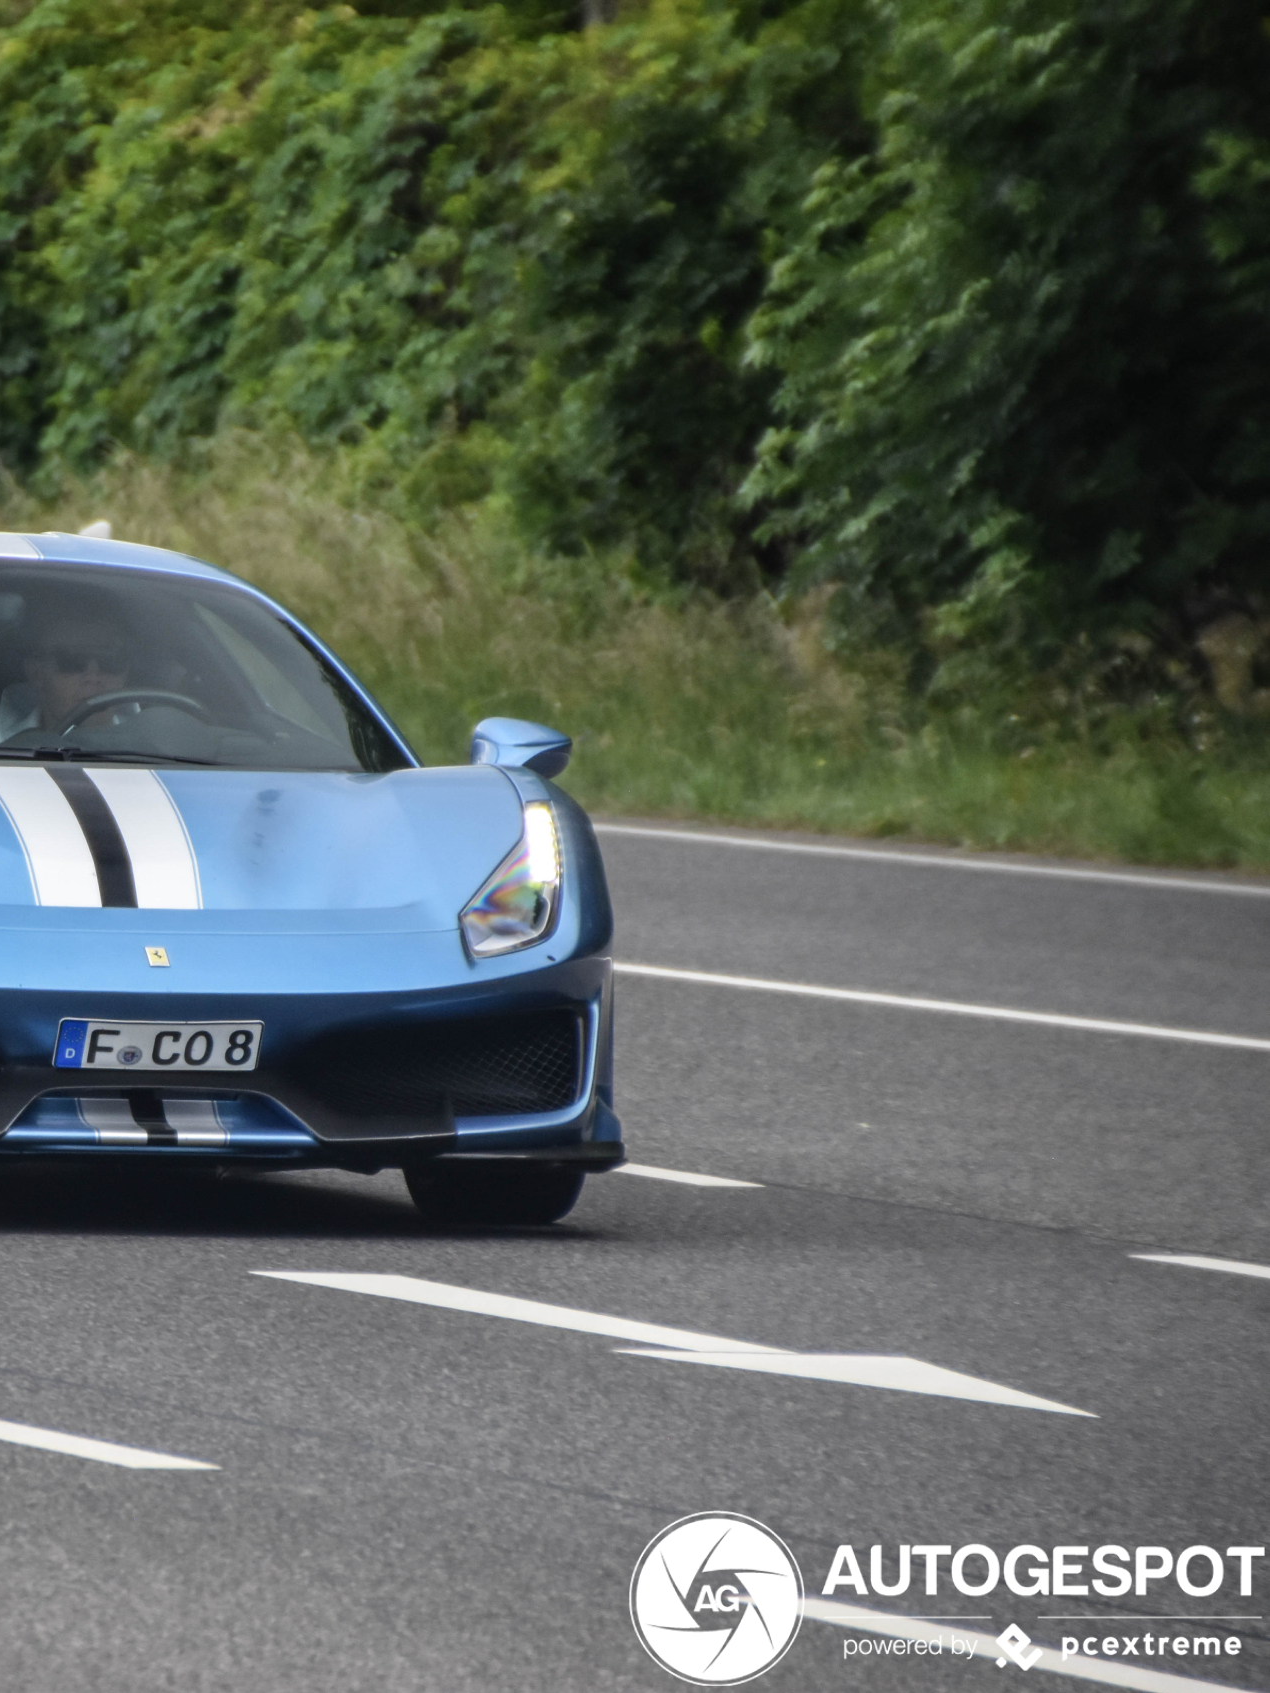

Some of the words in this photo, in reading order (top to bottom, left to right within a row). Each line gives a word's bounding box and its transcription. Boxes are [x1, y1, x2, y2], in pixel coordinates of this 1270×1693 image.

[65, 1048, 75, 1059] D
[87, 1029, 120, 1063] F
[151, 1031, 213, 1065] CO
[226, 1030, 254, 1065] 8
